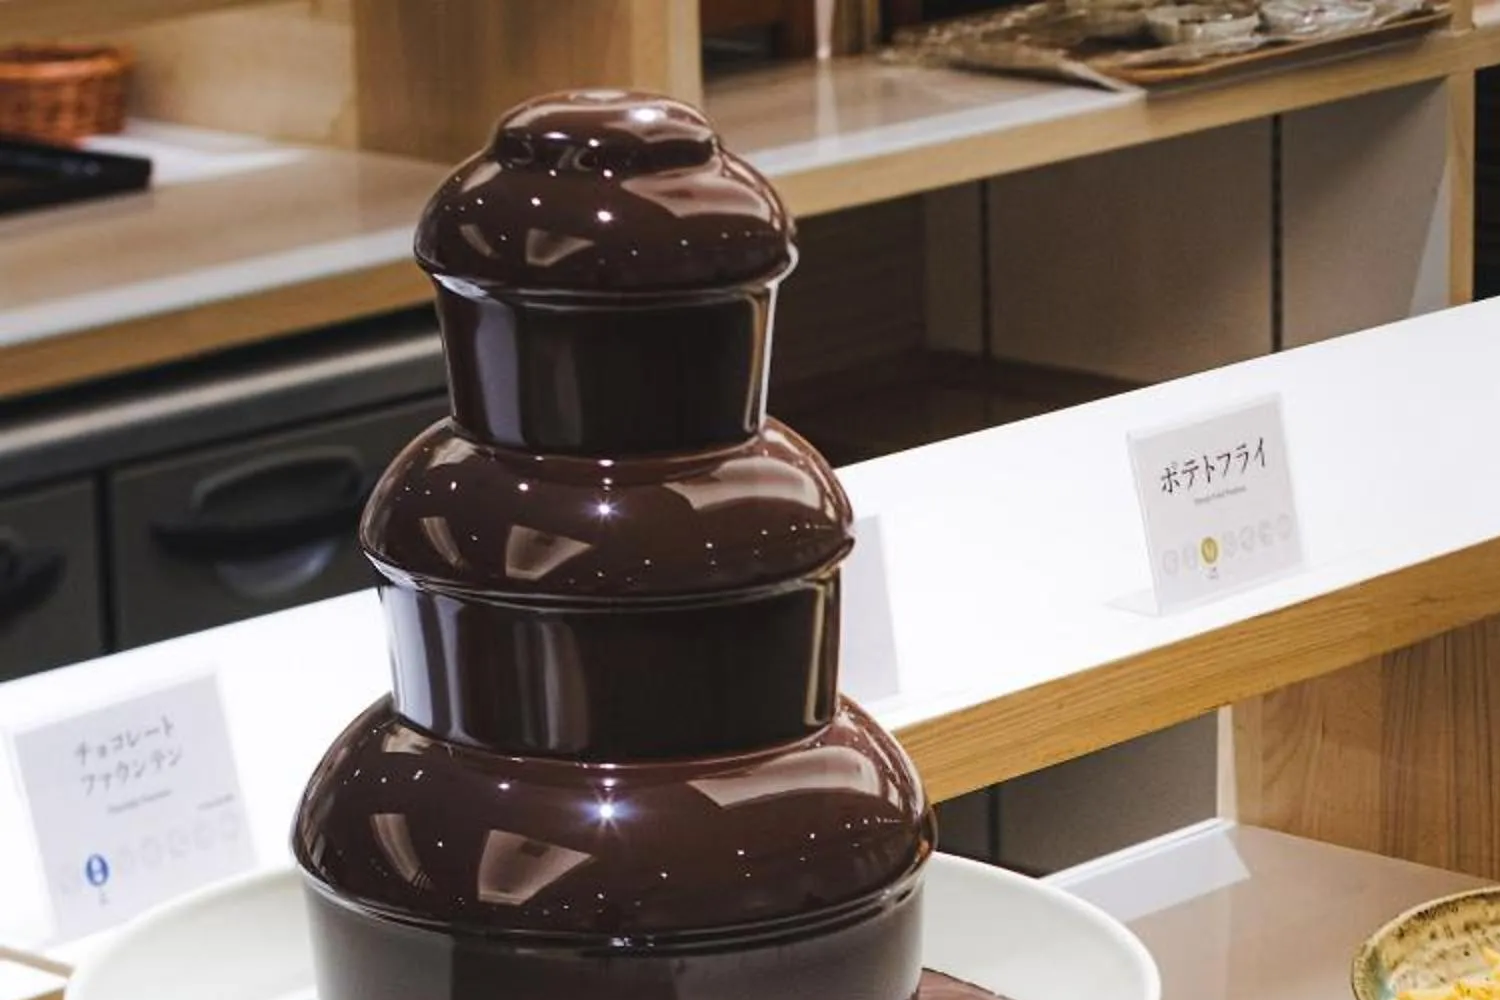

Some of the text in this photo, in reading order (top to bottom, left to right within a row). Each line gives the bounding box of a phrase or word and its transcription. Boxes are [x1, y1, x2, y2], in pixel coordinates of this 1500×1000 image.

[1160, 436, 1267, 494] ポテトフライ
[74, 714, 175, 767] チョコレート
